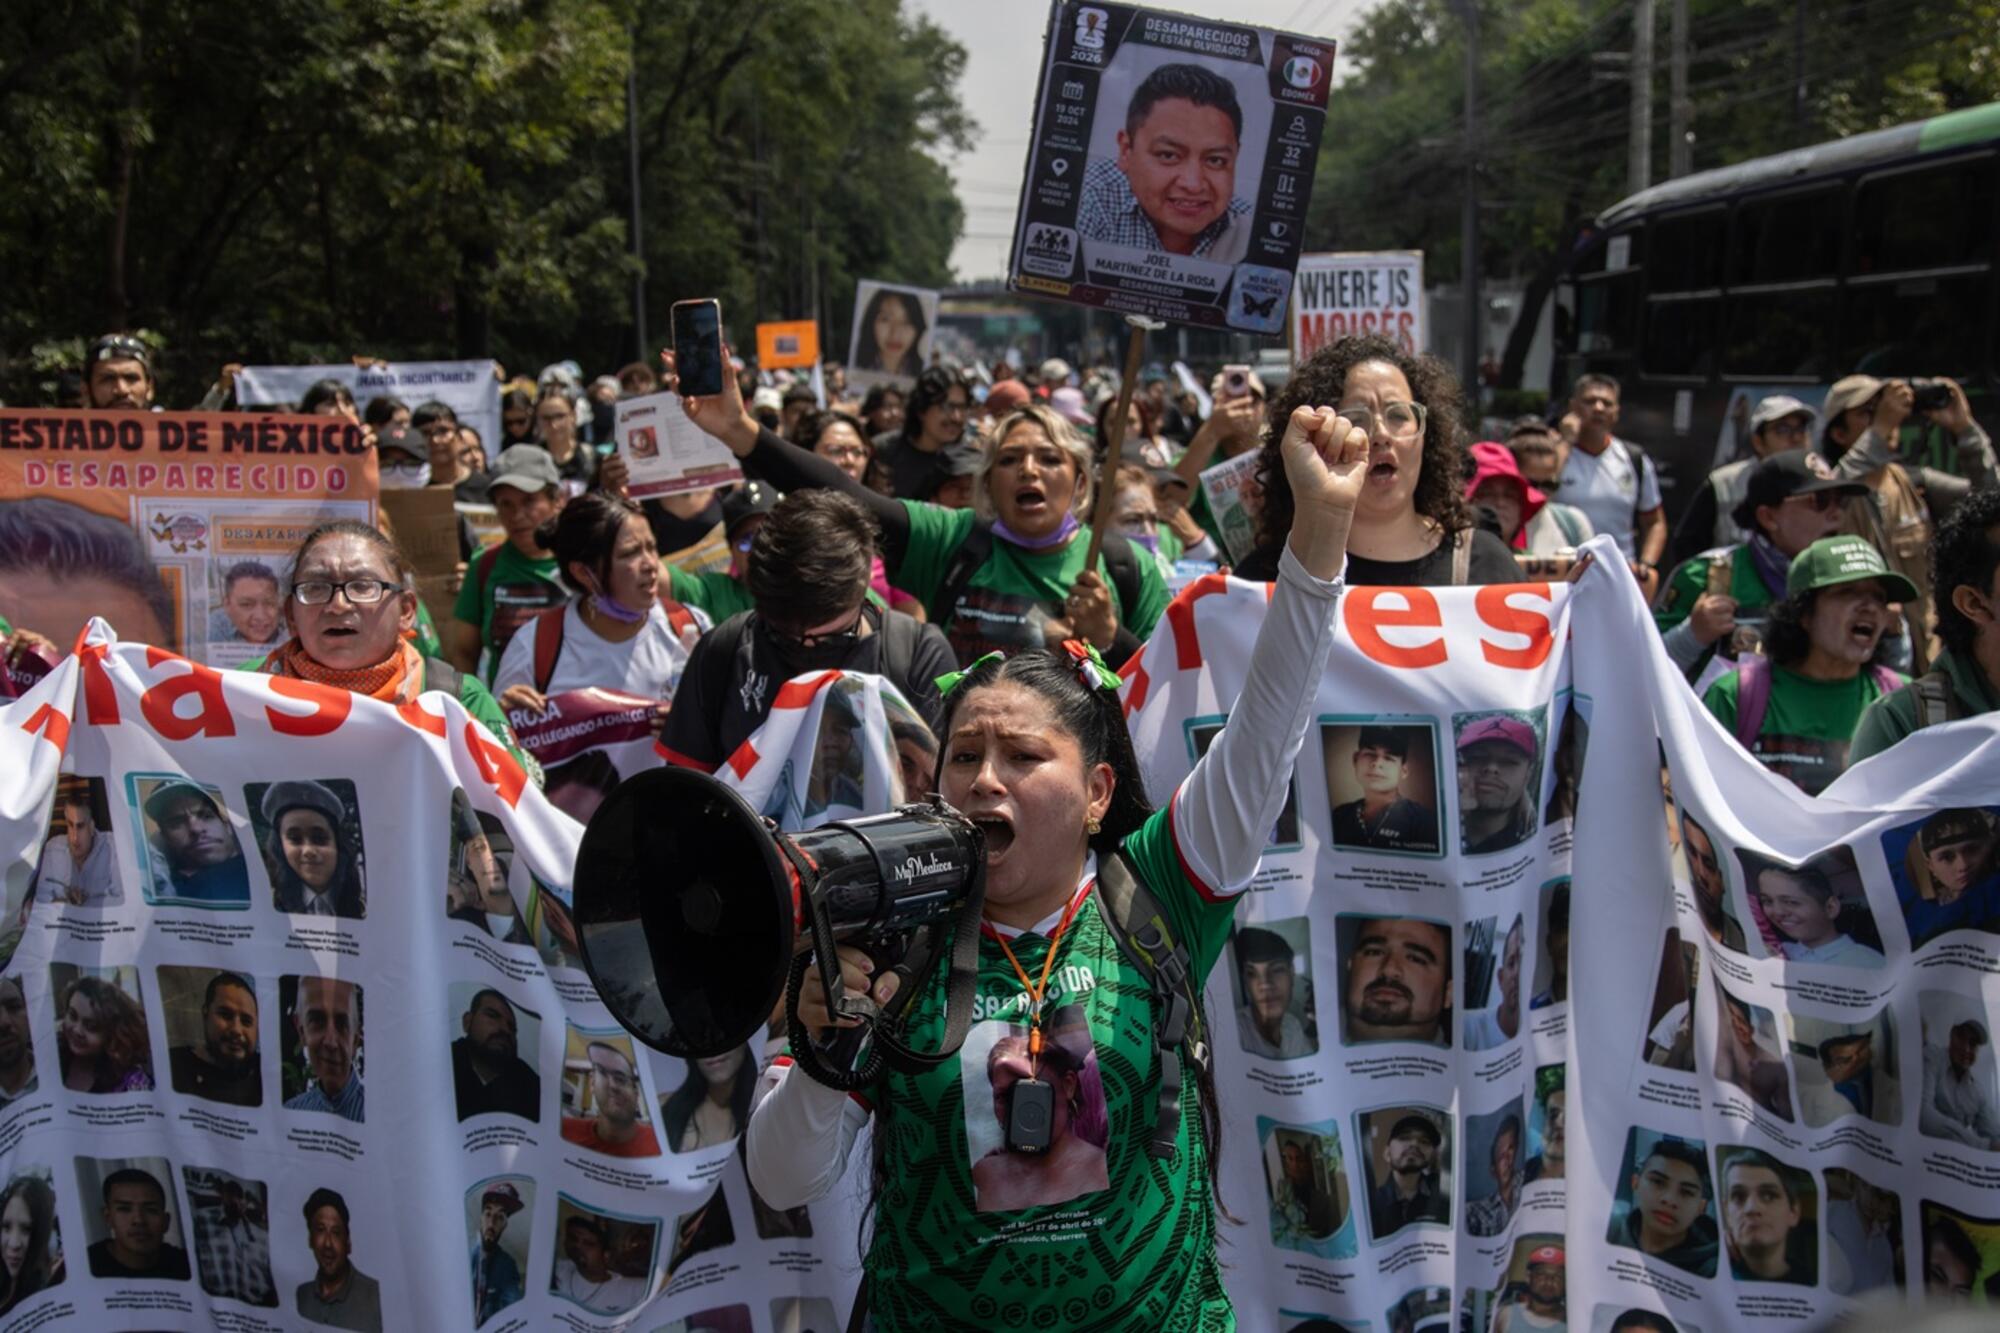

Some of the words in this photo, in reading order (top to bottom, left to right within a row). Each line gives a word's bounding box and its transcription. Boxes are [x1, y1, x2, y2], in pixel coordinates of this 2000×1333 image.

[1144, 31, 1158, 42] NO
[1159, 32, 1192, 48] ESTÁN
[1193, 39, 1248, 58] OLVIDADOS
[1145, 17, 1250, 47] DESAPARECIDOS
[1070, 50, 1102, 64] 2026
[1055, 103, 1066, 114] 19
[1067, 105, 1086, 117] OCT
[1056, 114, 1079, 126] 2024
[1285, 146, 1301, 159] 32
[1095, 256, 1153, 279] MARTÍNEZ
[1153, 268, 1168, 281] DE
[1170, 270, 1185, 283] LA
[1186, 273, 1216, 288] ROSA
[1142, 253, 1173, 269] JOEL
[1119, 278, 1184, 298] DESAPARECIDO
[1300, 269, 1380, 310] WHERE
[1387, 268, 1410, 308] IS
[0, 416, 146, 453] ESTADO
[158, 419, 209, 453] DE
[221, 414, 368, 456] MÉXICO
[24, 459, 349, 494] DESAPARECIDO
[541, 721, 596, 746] LLEGANDO
[596, 716, 605, 728] A
